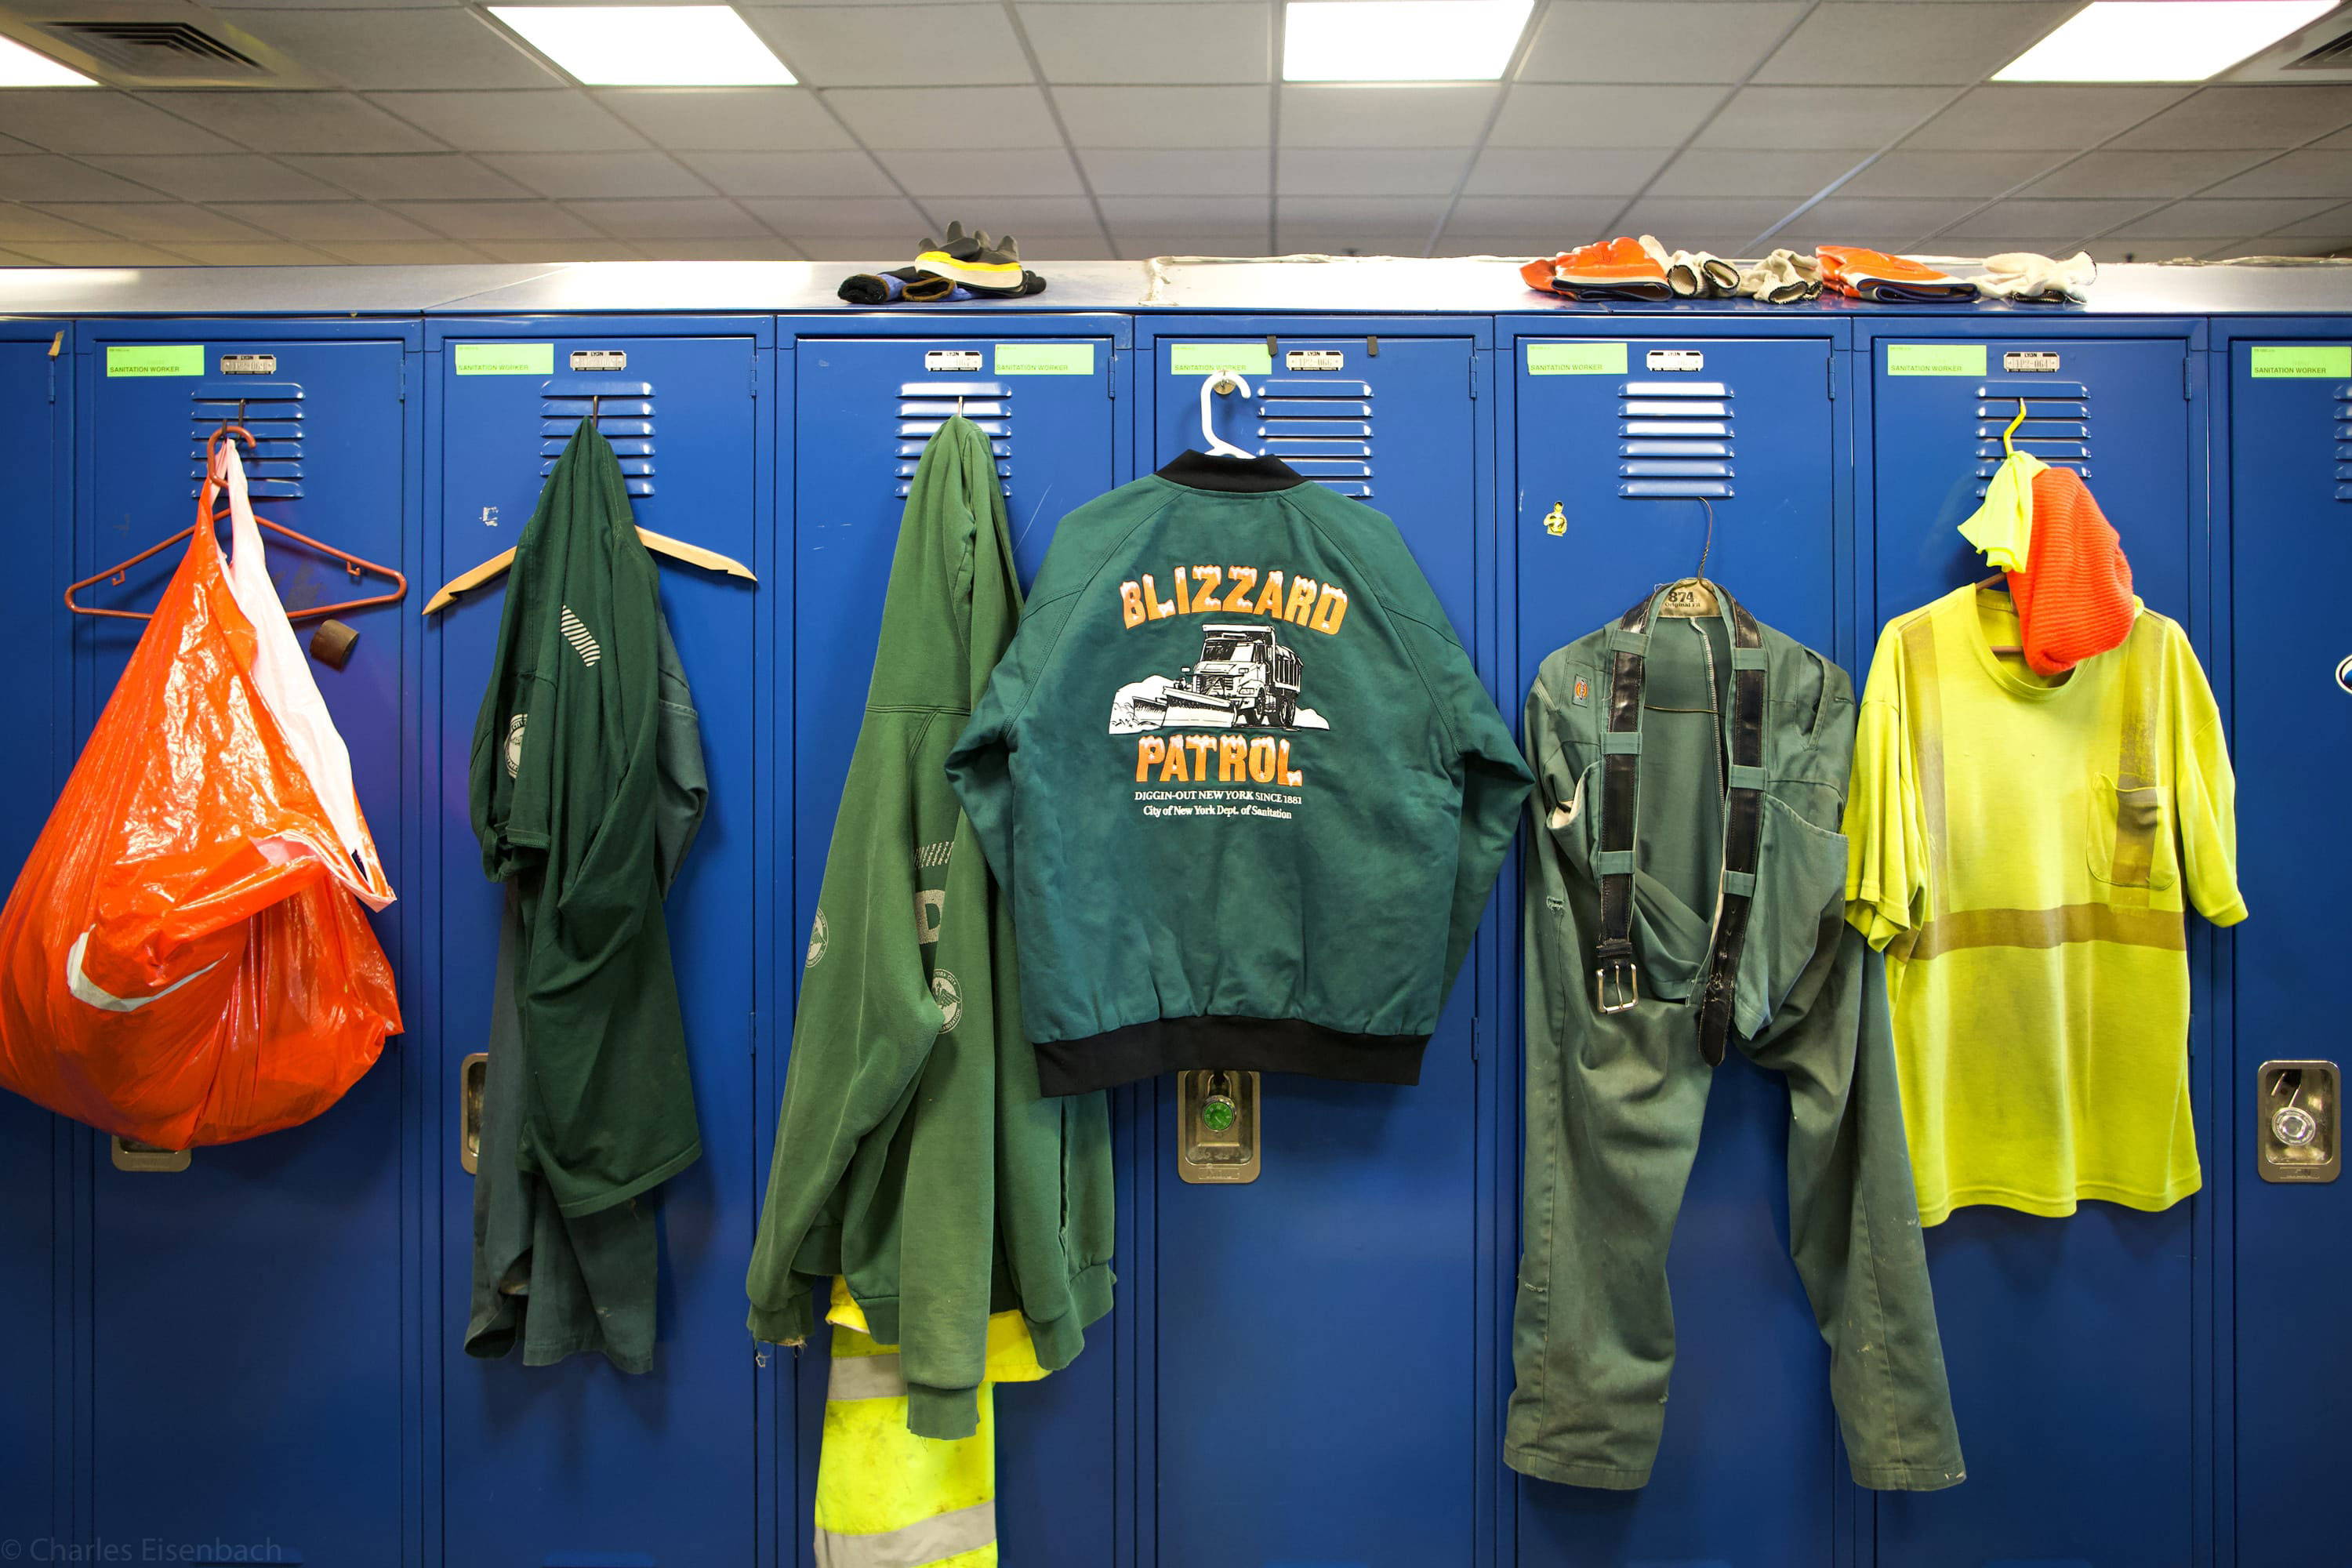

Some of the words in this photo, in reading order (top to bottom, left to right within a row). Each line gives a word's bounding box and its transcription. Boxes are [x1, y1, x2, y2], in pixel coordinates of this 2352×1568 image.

[1119, 564, 1348, 635] BLIZZARD
[1668, 591, 1693, 602] 874
[1135, 733, 1303, 787] PATROL
[1134, 790, 1197, 800] DIGGIN-OUT
[1198, 790, 1226, 800] NEW
[1225, 790, 1254, 800] YORK
[1255, 792, 1283, 803] SINCE
[1283, 795, 1302, 804] 1881
[1143, 804, 1162, 818] City
[1163, 805, 1174, 815] of
[1174, 806, 1193, 815] New
[1193, 805, 1215, 815] York
[1217, 805, 1239, 817] Dept.
[1240, 805, 1252, 815] of
[1252, 806, 1292, 819] Sanitation
